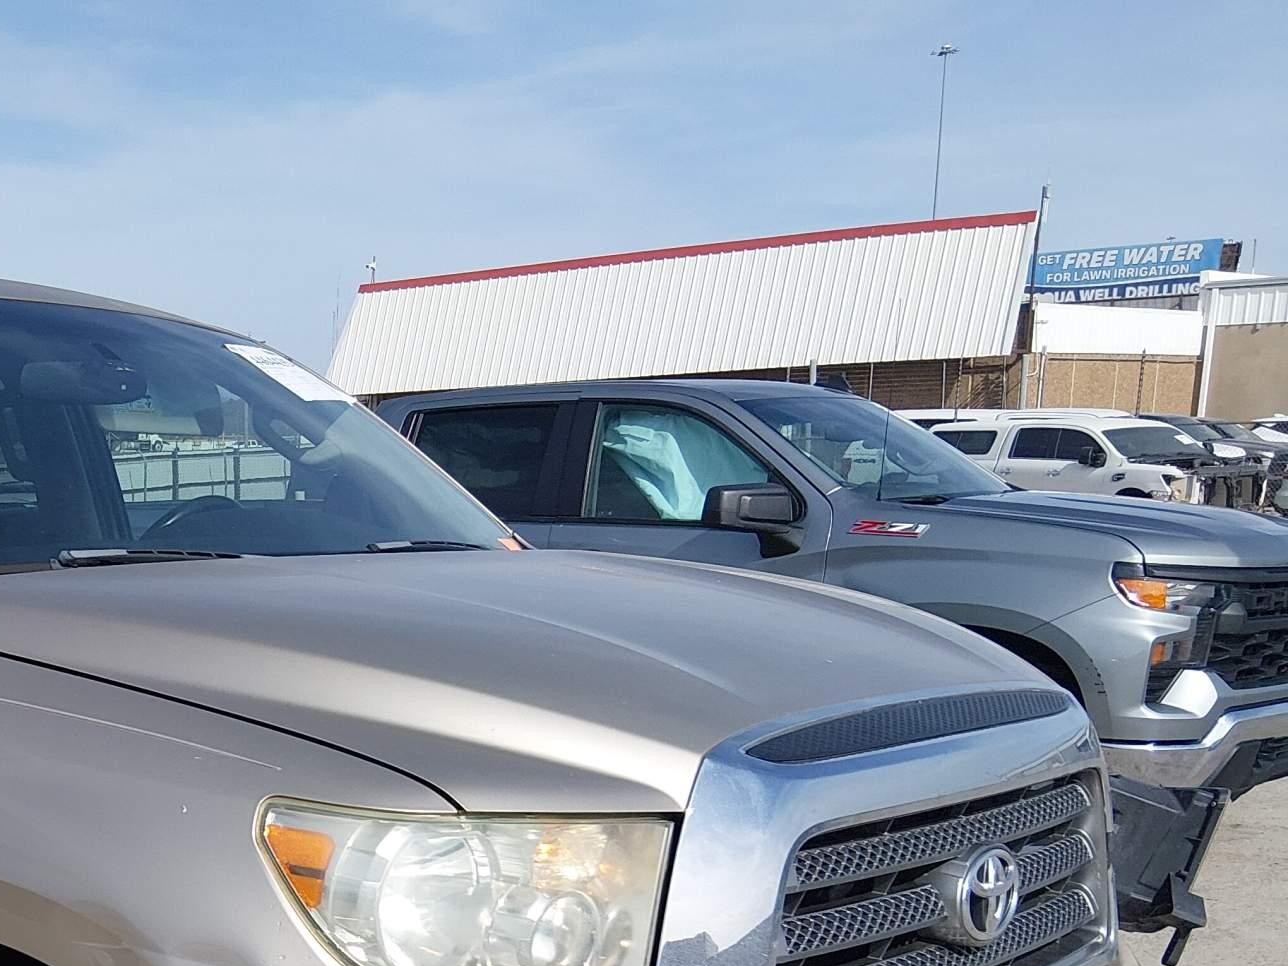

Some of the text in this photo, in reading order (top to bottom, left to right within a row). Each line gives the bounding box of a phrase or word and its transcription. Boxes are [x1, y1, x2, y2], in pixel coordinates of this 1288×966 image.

[1038, 243, 1204, 270] GET FREE WATER
[1046, 263, 1190, 283] FOR LAWN IRRIGATION
[1079, 287, 1122, 302] WELL
[1124, 282, 1200, 299] DRILLING
